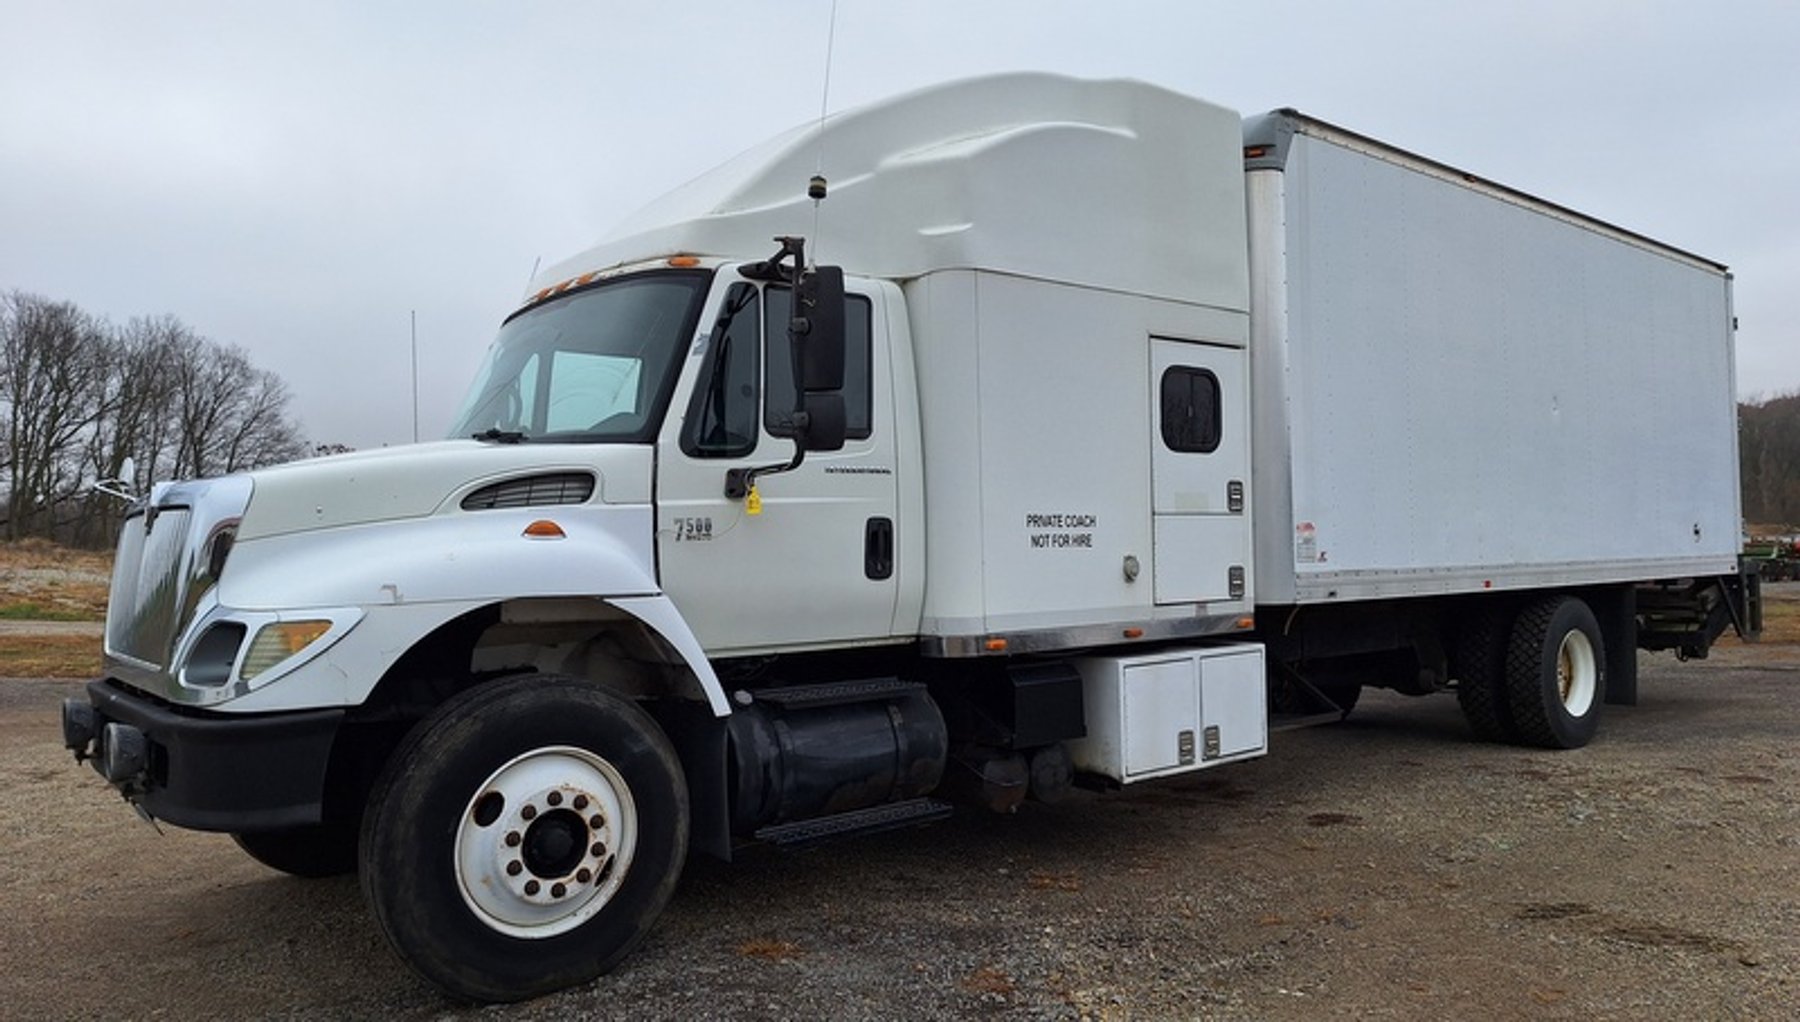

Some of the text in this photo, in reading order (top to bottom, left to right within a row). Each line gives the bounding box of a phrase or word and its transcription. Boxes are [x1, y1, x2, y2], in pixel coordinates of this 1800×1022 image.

[1026, 514, 1097, 528] PRIVATE COACH
[1030, 533, 1093, 548] NOT FOR HIRE
